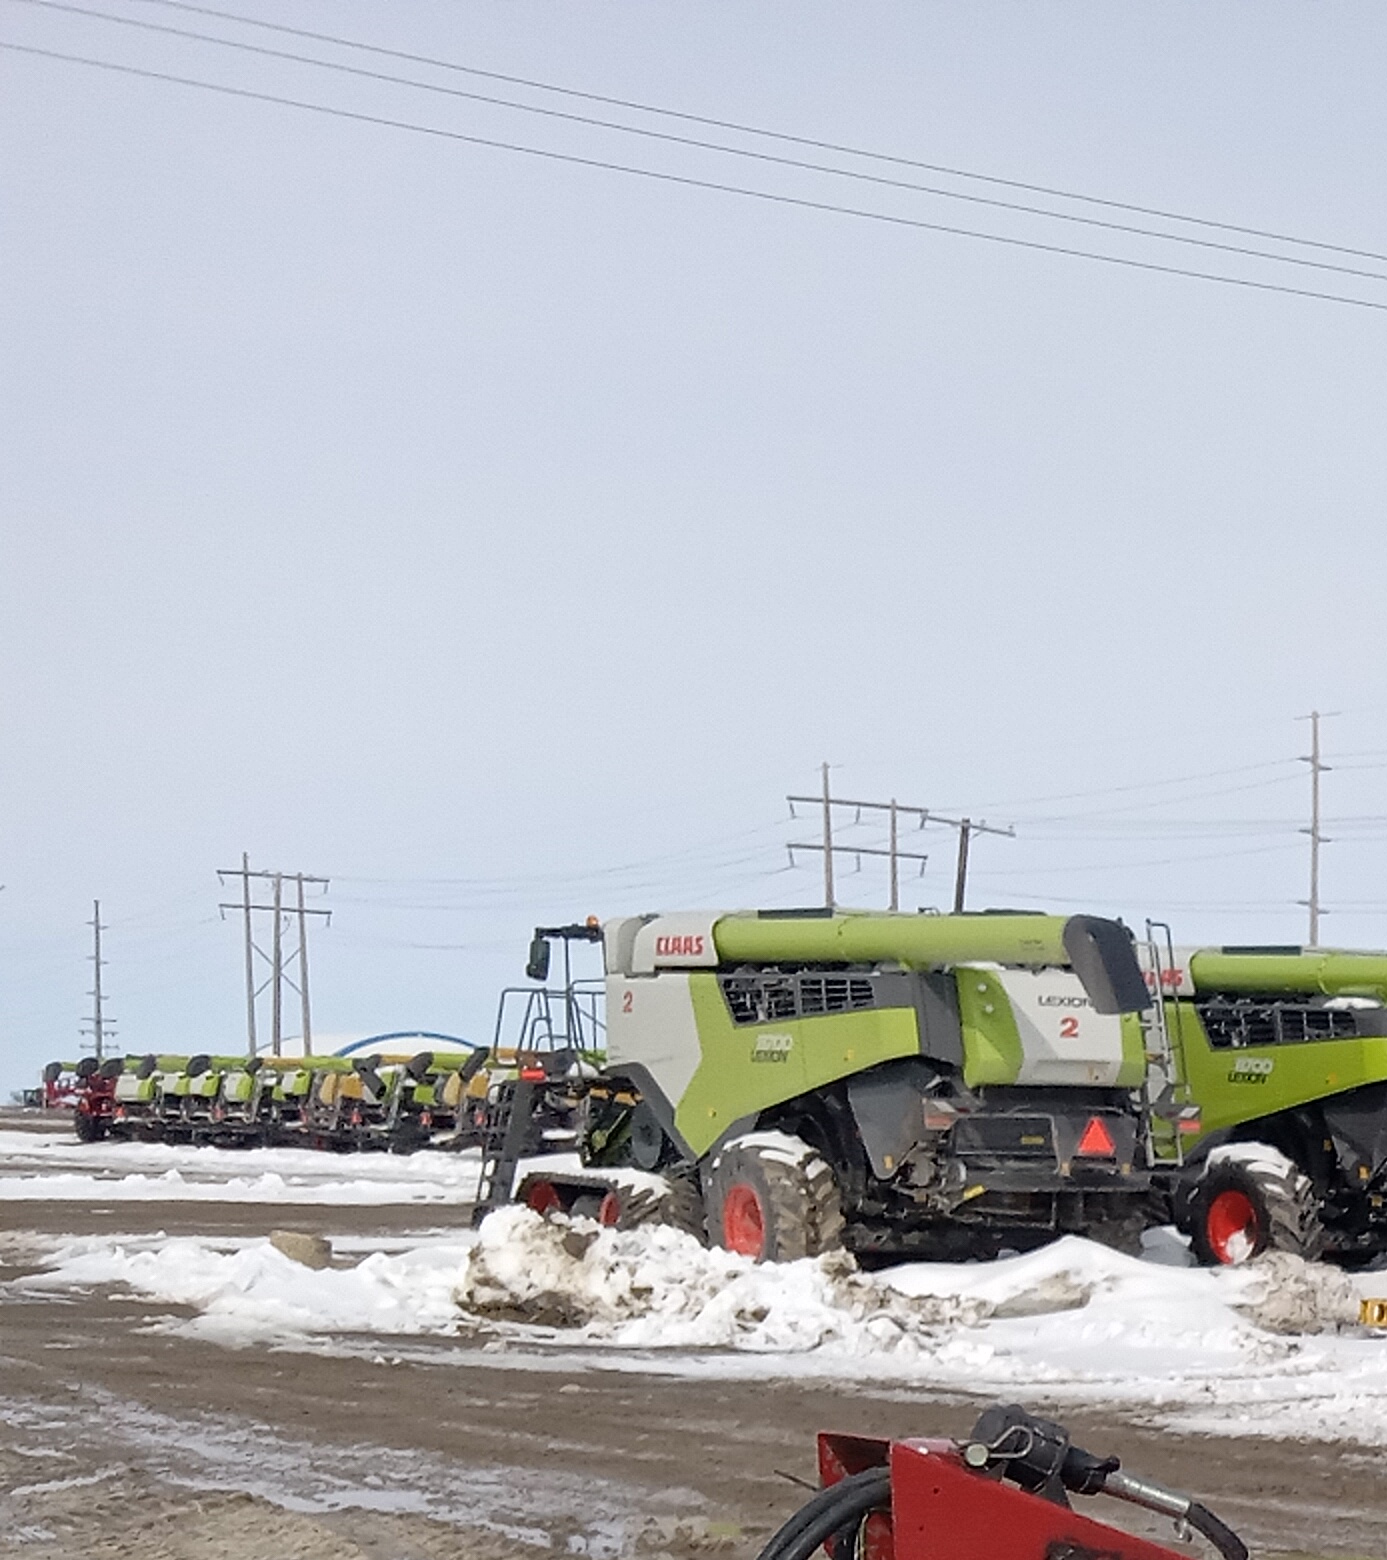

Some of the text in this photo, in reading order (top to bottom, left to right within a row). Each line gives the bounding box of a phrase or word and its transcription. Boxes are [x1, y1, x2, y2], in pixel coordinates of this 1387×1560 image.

[656, 936, 704, 955] CLAAS
[623, 990, 633, 1013] 2
[1060, 1017, 1079, 1038] 2
